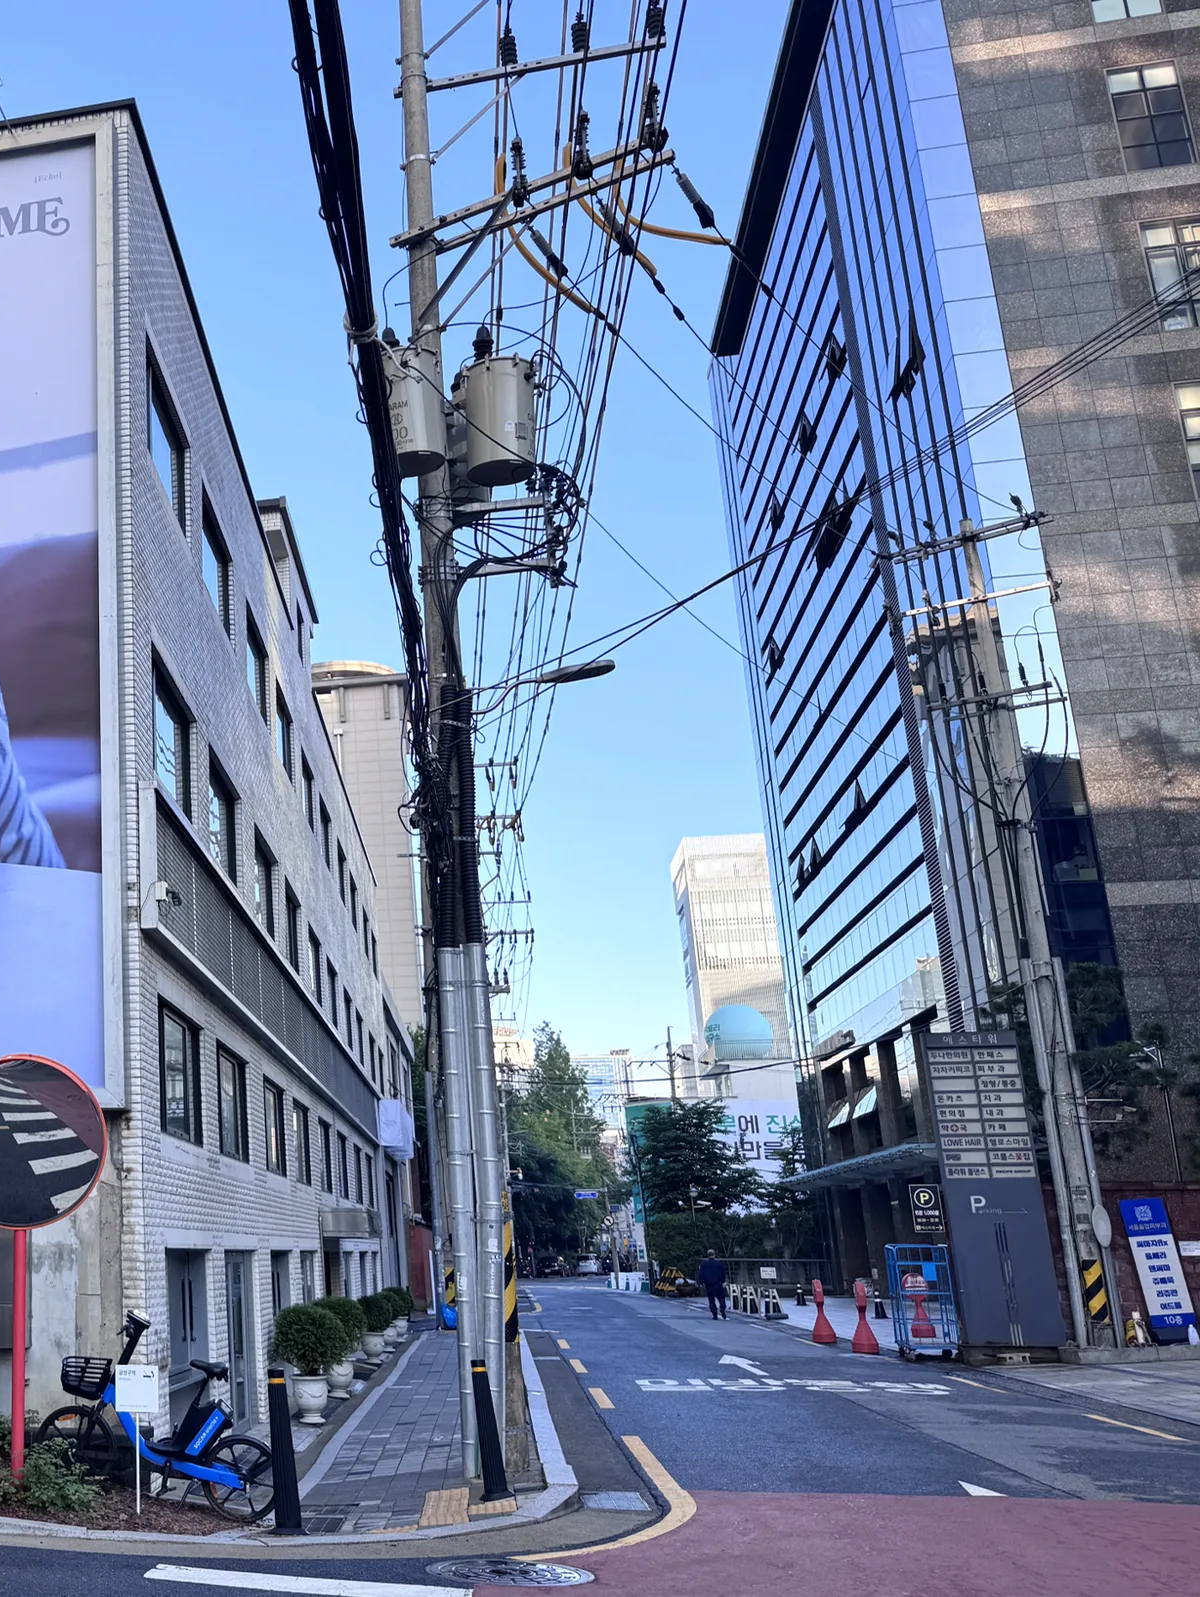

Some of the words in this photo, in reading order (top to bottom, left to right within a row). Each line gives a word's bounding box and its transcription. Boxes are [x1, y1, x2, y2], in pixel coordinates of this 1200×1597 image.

[34, 171, 63, 184] [Echo]
[965, 1138, 982, 1146] HAIR
[920, 1192, 930, 1204] P
